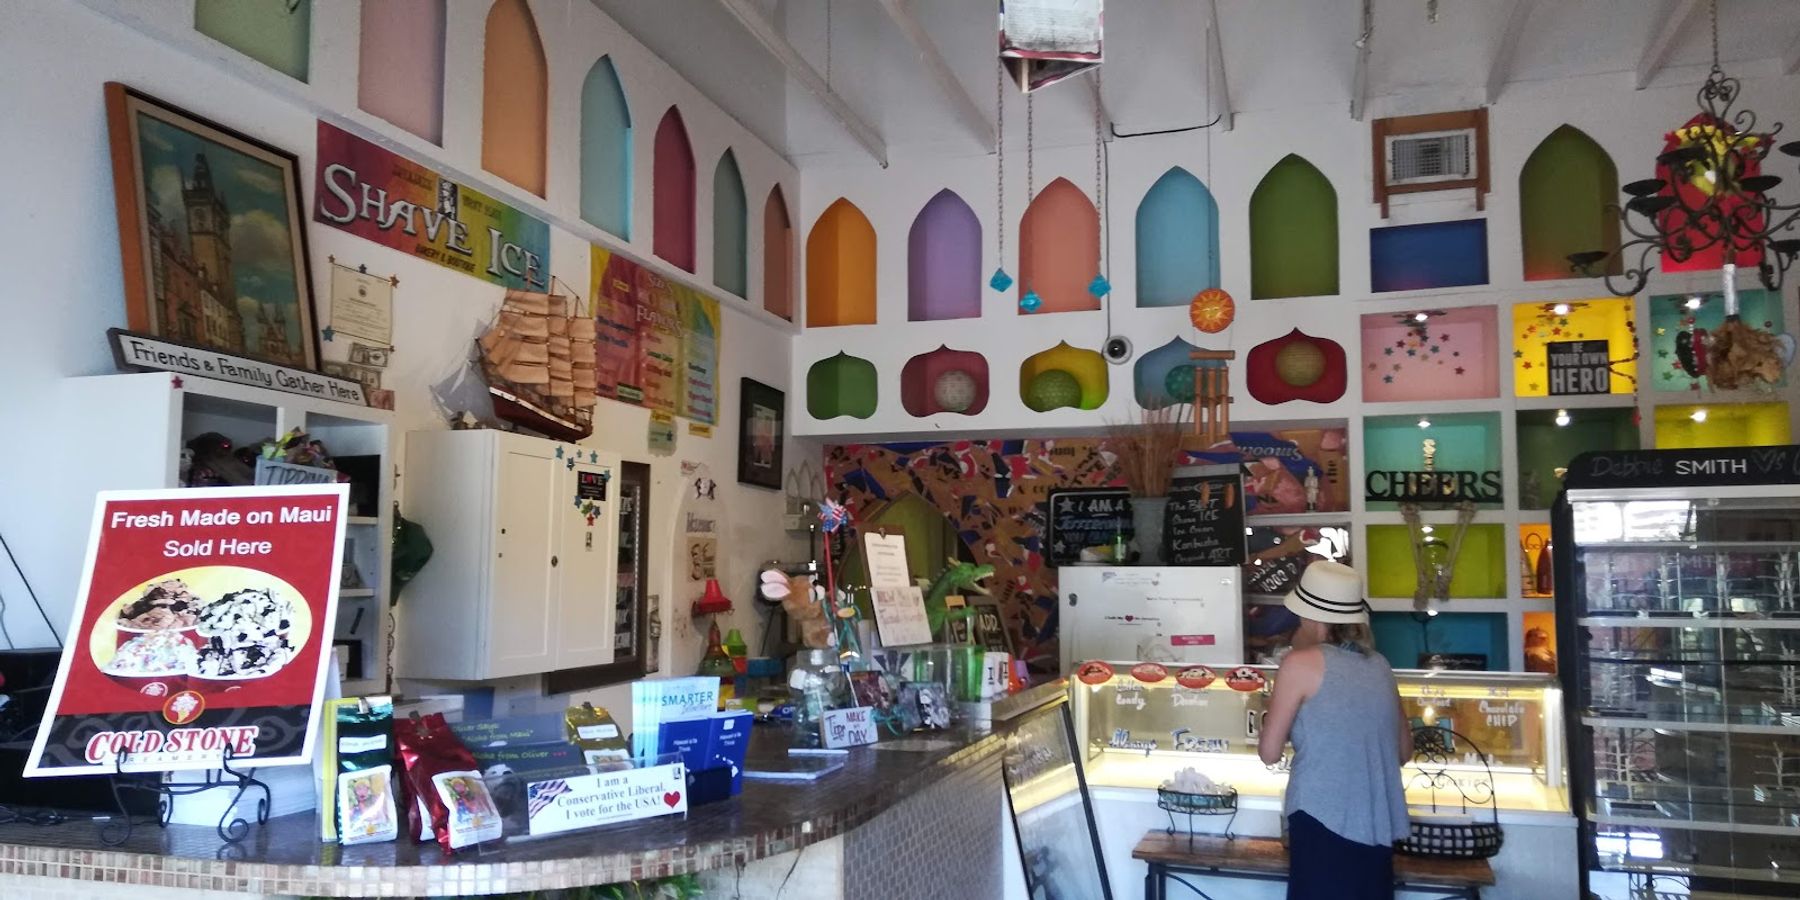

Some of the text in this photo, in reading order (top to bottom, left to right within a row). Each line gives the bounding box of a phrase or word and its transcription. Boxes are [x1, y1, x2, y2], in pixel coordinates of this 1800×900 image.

[320, 163, 545, 286] SHAVE ICE
[1572, 342, 1583, 353] BE
[1550, 352, 1608, 367] YOUR OWN
[130, 340, 360, 401] Friends & Family Gather Here
[1551, 367, 1609, 393] HERO
[1675, 459, 1748, 475] SMITH
[1366, 470, 1503, 499] CHEERS
[1088, 499, 1112, 512] AM
[111, 505, 332, 528] Fresh Made on Maui
[1200, 510, 1220, 522] ICE
[163, 538, 272, 557] Sold Here
[661, 691, 714, 706] SMARTER
[846, 711, 866, 723] MAKE
[1486, 715, 1518, 727] CHIP
[848, 730, 868, 744] DAY
[87, 728, 255, 762] COLD STONE
[497, 751, 520, 761] from
[521, 751, 549, 760] Oliver
[597, 777, 601, 788] I
[604, 777, 620, 786] am
[558, 787, 625, 807] Conservative
[566, 795, 661, 820] I vote for the USA!
